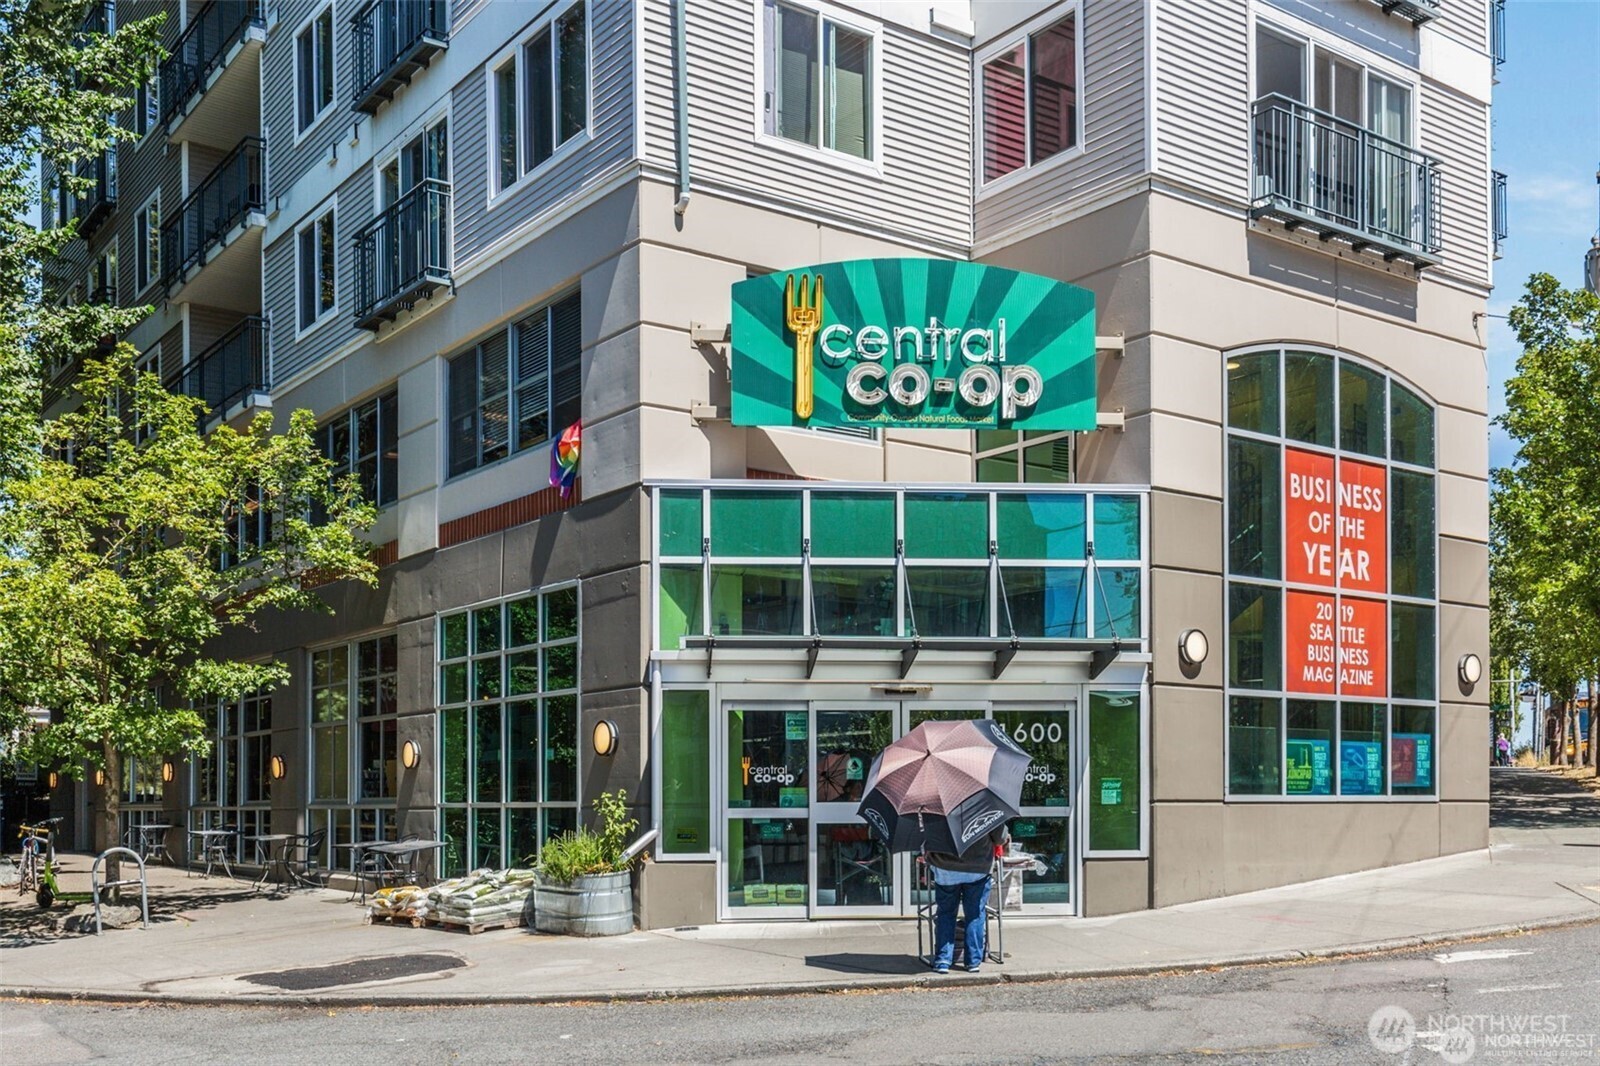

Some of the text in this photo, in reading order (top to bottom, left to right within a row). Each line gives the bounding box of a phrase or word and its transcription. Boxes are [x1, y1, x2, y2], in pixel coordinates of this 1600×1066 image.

[820, 316, 1006, 362] central
[846, 362, 1043, 419] co-op
[919, 413, 946, 423] Natural
[1290, 473, 1382, 513] BUSINESS
[1308, 511, 1365, 540] OF THE
[1303, 541, 1370, 582] YEAR
[1316, 602, 1354, 622] 2019
[1309, 623, 1365, 644] SEATTLE
[1307, 644, 1369, 666] BUSINESS
[1303, 665, 1374, 686] MAGAZINE
[748, 764, 788, 775] central
[754, 773, 794, 786] co-op
[1025, 773, 1056, 784] o-op
[1026, 764, 1049, 774] ntral
